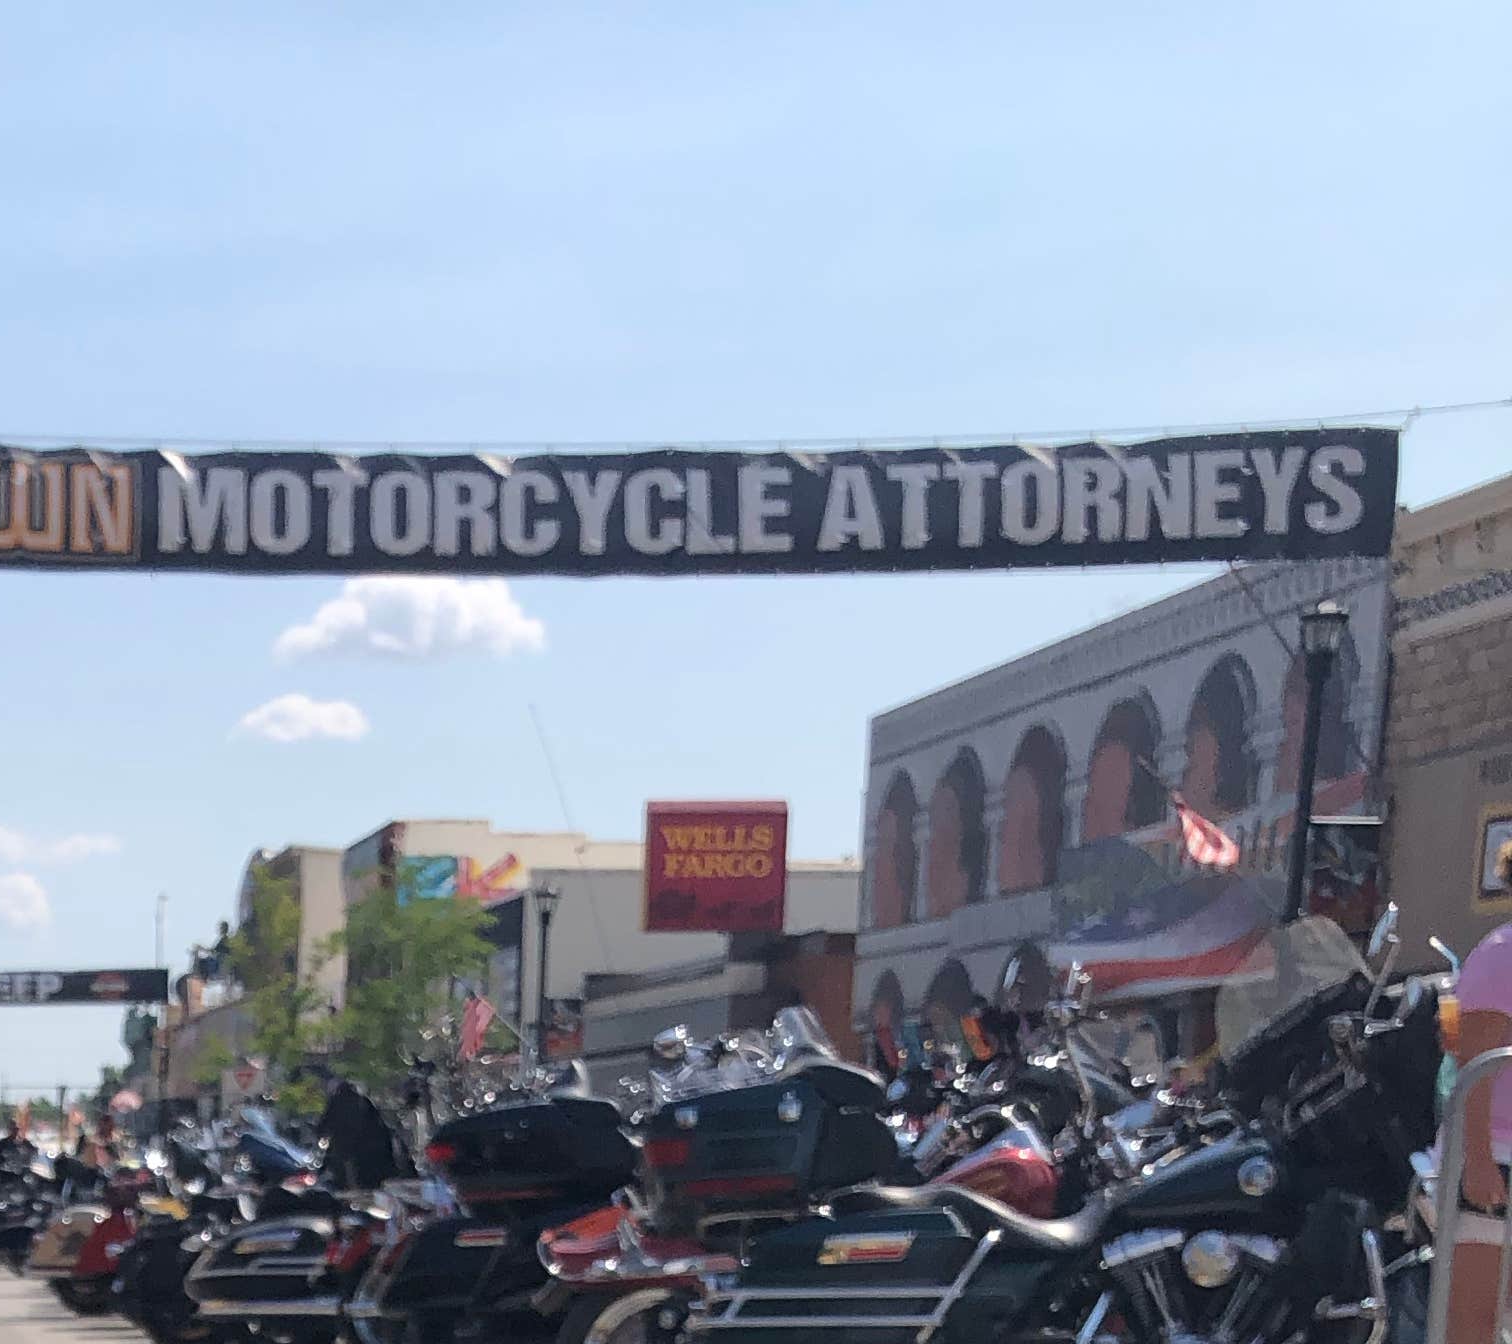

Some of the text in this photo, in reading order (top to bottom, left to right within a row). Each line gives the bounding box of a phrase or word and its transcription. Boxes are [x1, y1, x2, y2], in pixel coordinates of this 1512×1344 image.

[156, 463, 795, 556] MOTORCYCLE
[816, 445, 1366, 552] ATTORNEYS
[661, 824, 774, 851] WELLS
[663, 853, 774, 879] FARGO
